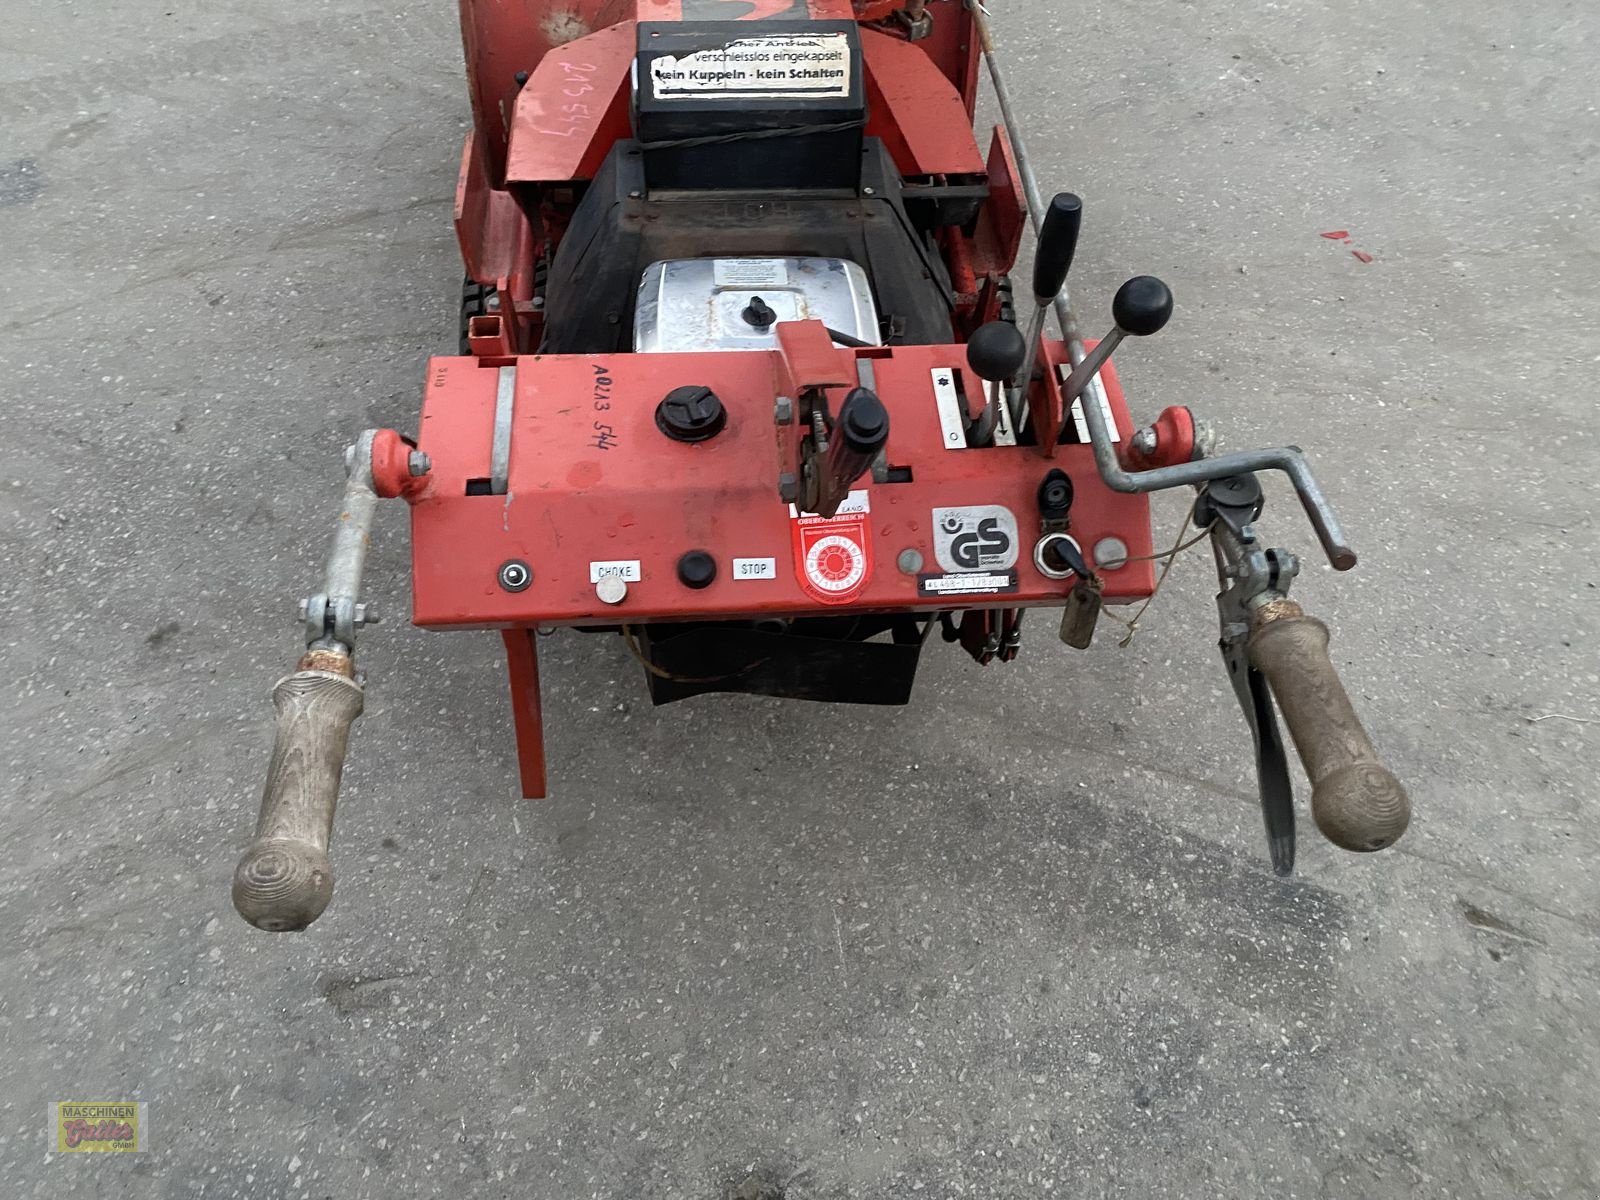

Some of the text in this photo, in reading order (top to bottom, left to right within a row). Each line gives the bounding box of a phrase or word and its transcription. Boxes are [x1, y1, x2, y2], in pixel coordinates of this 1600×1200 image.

[693, 50, 843, 64] verschleisslos eingekapselt
[689, 69, 746, 83] Kuppeln
[756, 68, 786, 80] kein
[788, 67, 844, 79] Schalten
[598, 566, 632, 578] CHOKE
[741, 563, 767, 575] STOP
